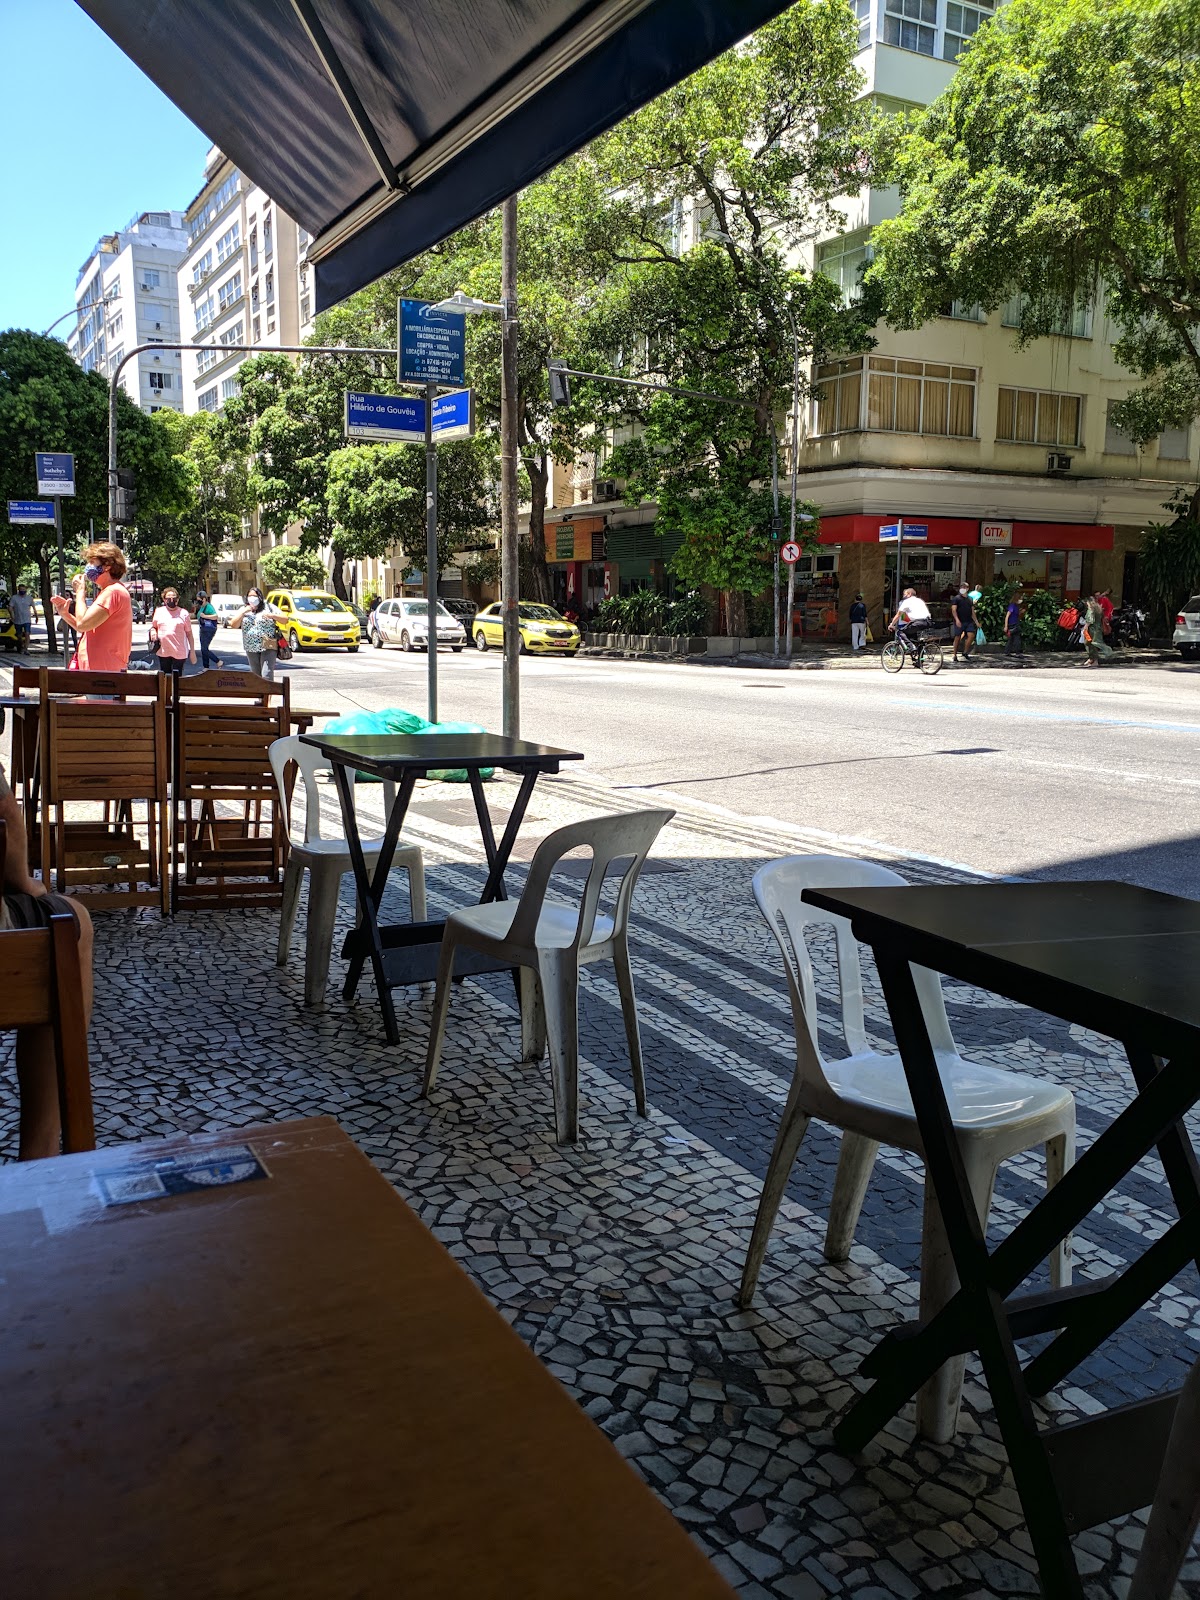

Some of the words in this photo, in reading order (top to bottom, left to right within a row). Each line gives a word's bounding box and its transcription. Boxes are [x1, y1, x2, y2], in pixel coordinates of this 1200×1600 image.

[434, 328, 460, 336] ESPECIALISTA
[423, 333, 449, 342] COPACABANA
[406, 348, 425, 356] LOCAÇÃO
[429, 350, 460, 360] ADMINISTRAÇÃO
[350, 394, 364, 402] Rua
[350, 403, 374, 412] Hilário
[568, 573, 574, 594] 4
[604, 571, 610, 596] 5
